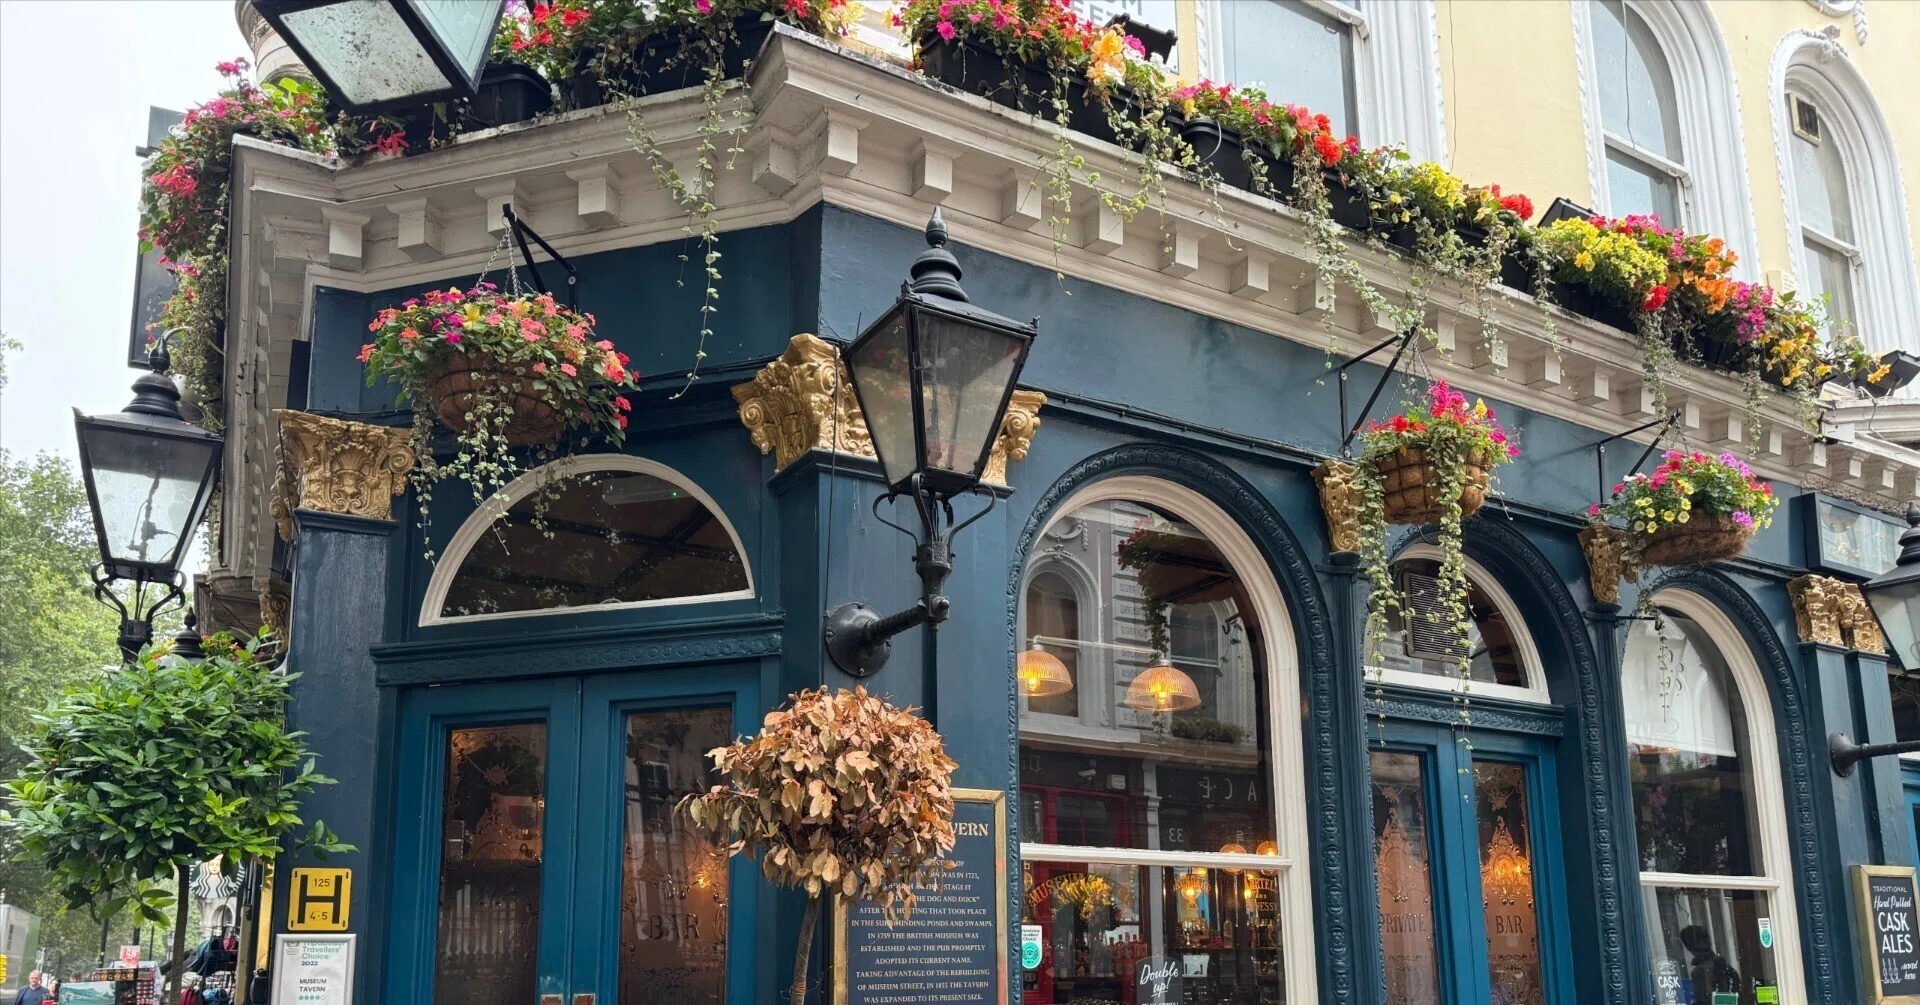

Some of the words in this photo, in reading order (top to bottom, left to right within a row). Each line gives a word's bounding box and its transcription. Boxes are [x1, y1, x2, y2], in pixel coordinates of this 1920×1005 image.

[949, 822, 989, 837] VERN
[313, 878, 331, 887] 125
[1872, 885, 1908, 893] TRADITIONAL
[296, 874, 343, 924] H
[1873, 895, 1890, 911] Hand
[1890, 895, 1912, 910] Pulled
[649, 913, 700, 940] BAR
[1495, 915, 1524, 934] BAR
[1877, 911, 1910, 932] CASK
[1881, 933, 1914, 954] ALES
[301, 952, 330, 960] Choice
[1139, 961, 1180, 985] Double
[298, 985, 327, 993] TAVERN
[899, 982, 926, 990] STREET,
[1657, 975, 1681, 989] CASK
[863, 996, 879, 1004] WAS
[880, 995, 917, 1003] EXPANDED
[928, 994, 939, 1002] ITS
[967, 993, 984, 1001] SIZE.
